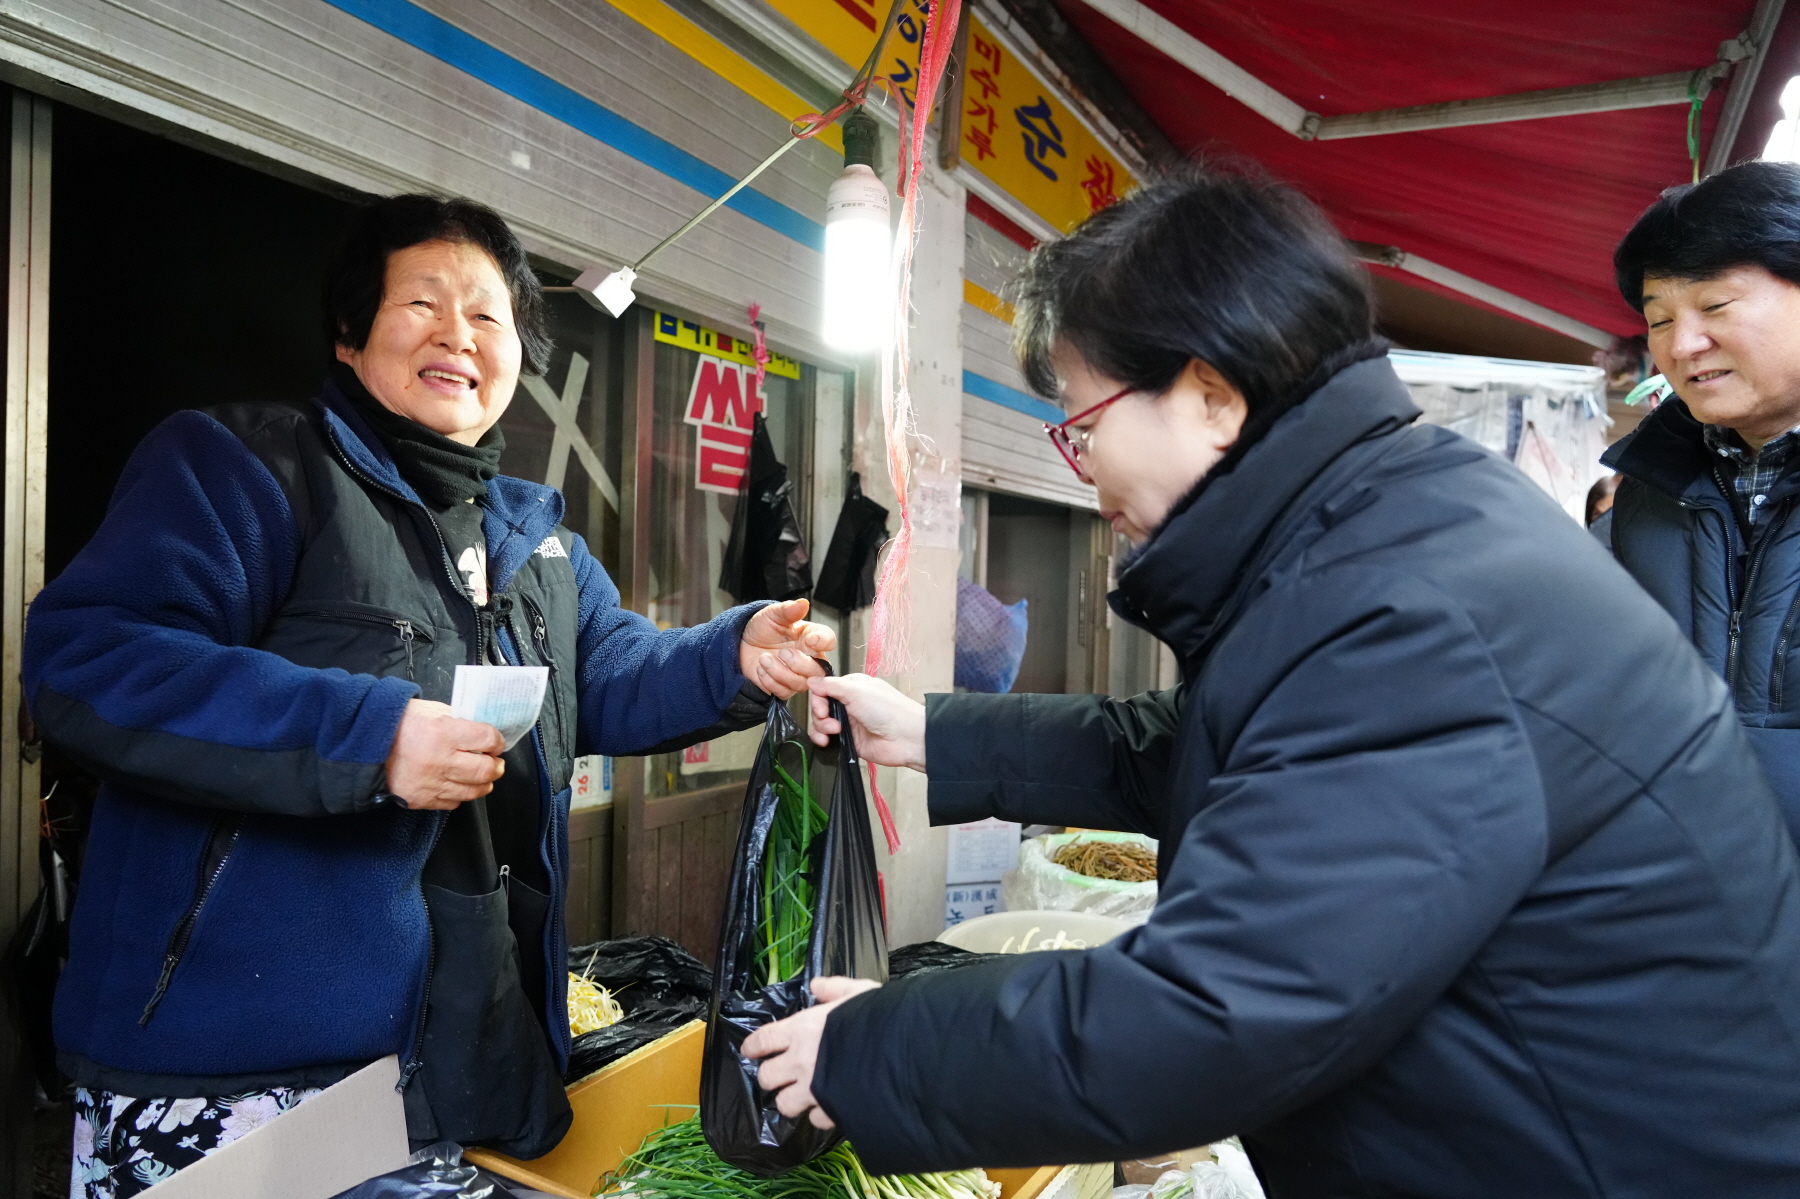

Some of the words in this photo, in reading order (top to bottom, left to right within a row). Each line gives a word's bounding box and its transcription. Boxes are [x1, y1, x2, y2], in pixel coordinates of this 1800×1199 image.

[965, 33, 1001, 161] 미수가루
[687, 356, 766, 493] 쌀
[577, 774, 589, 795] 26
